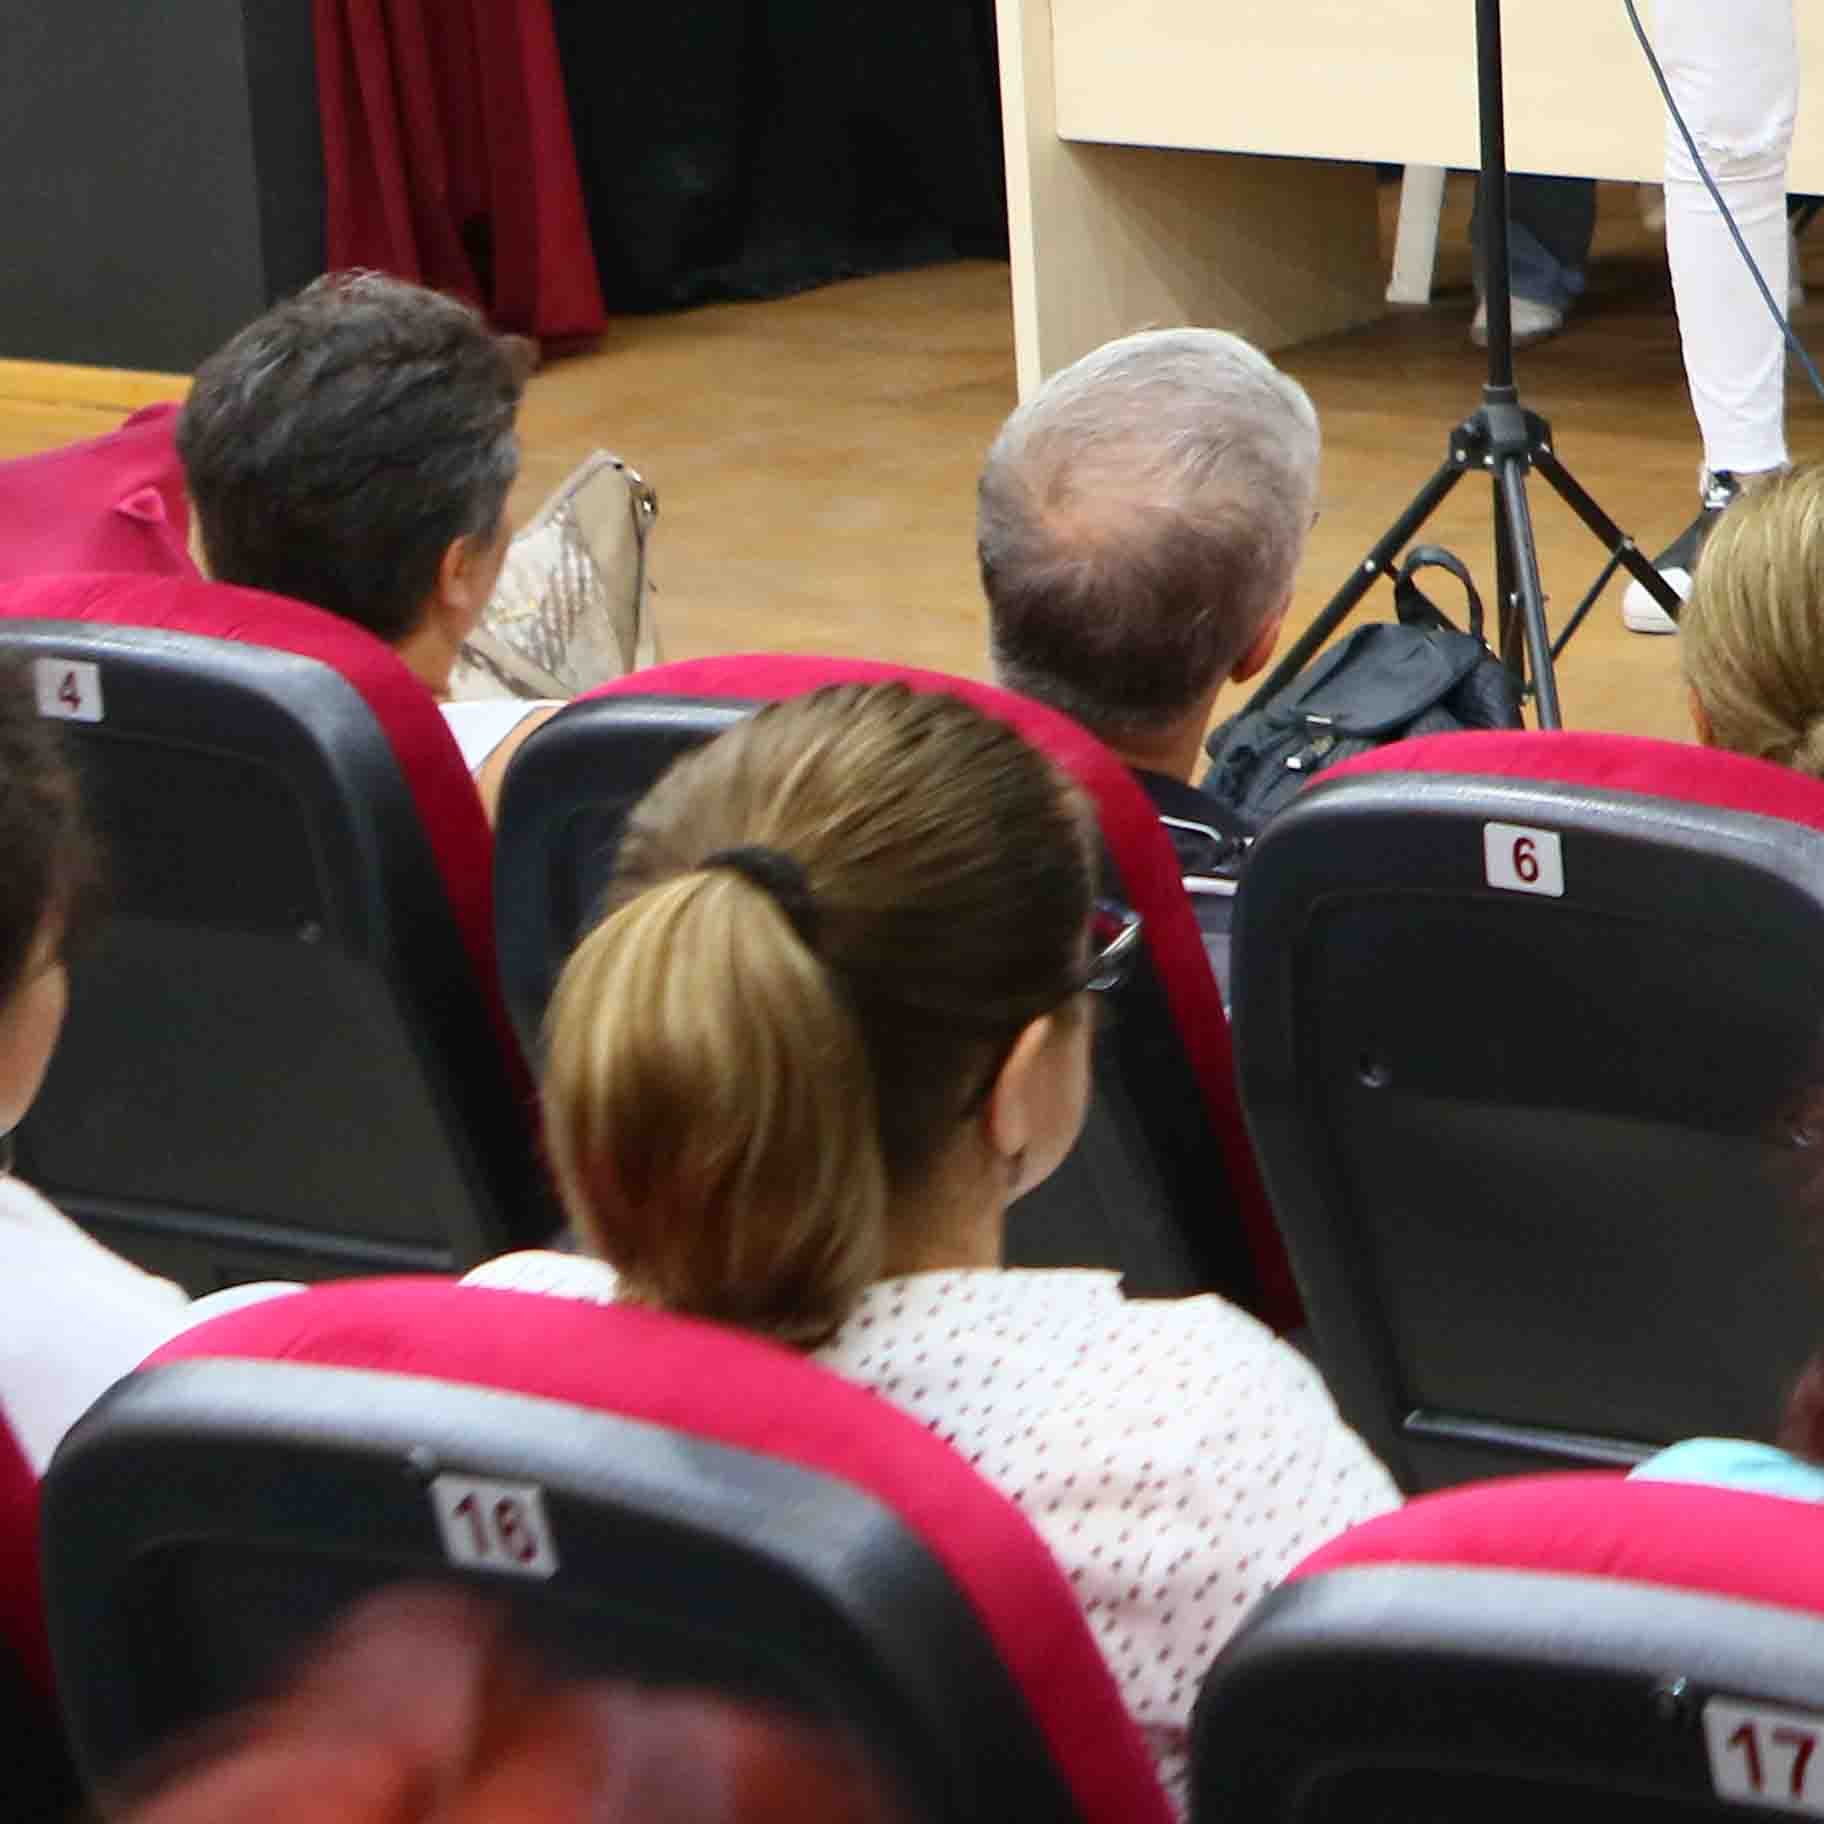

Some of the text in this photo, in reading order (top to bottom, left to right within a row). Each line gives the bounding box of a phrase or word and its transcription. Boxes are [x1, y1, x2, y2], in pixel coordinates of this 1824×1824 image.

[57, 671, 82, 710] 4
[1513, 837, 1539, 882] 6
[453, 1489, 541, 1564] 16
[1726, 1721, 1819, 1797] 17
